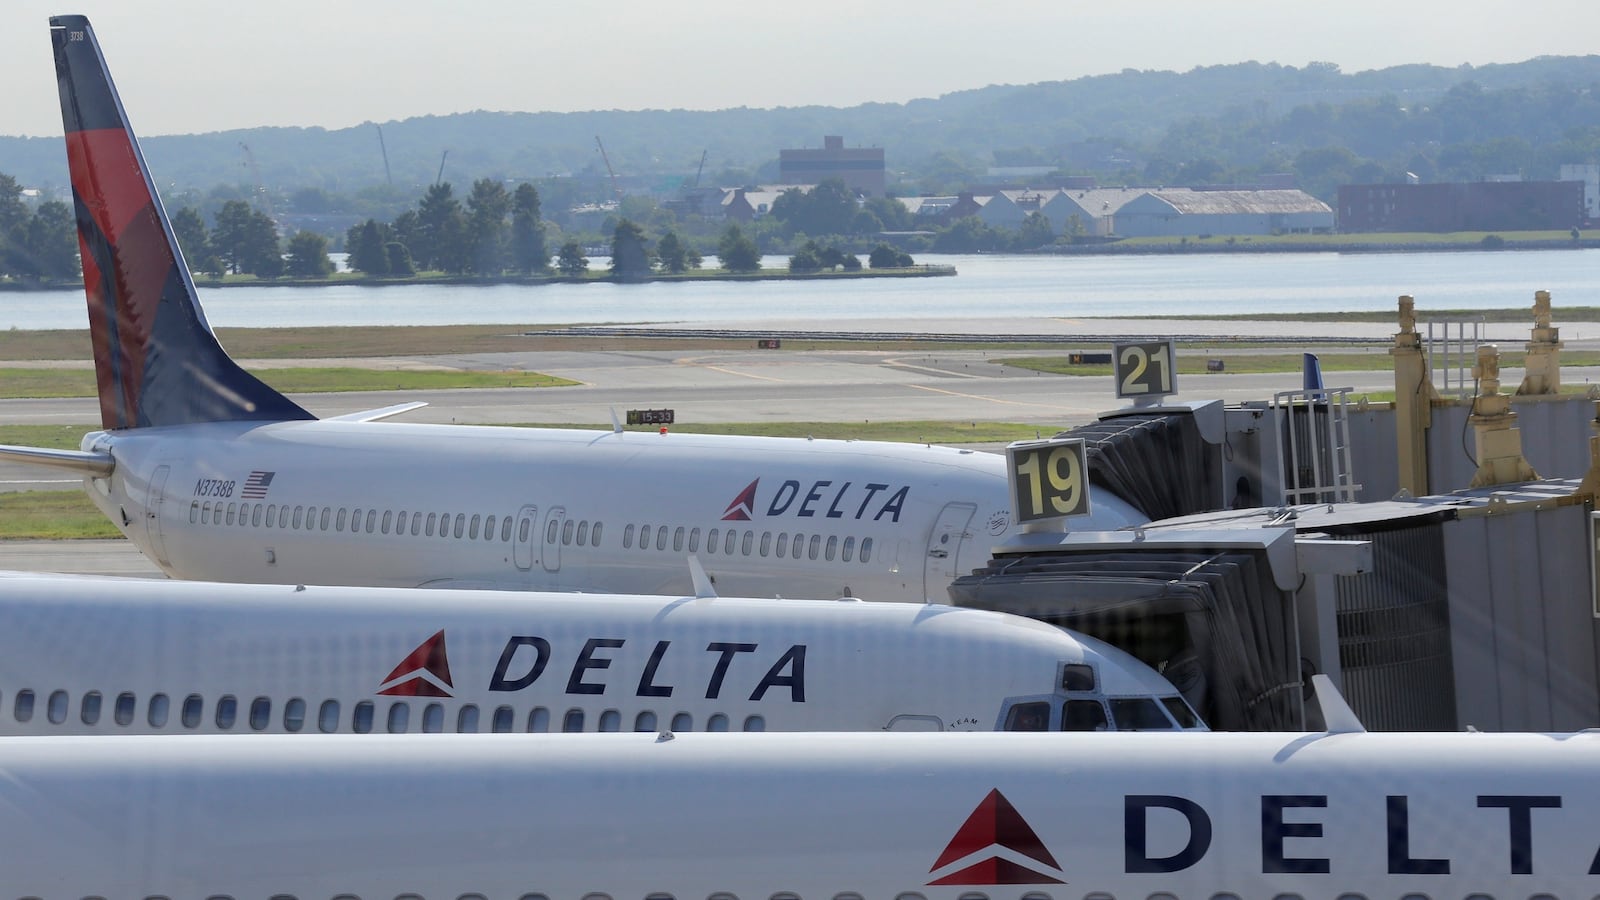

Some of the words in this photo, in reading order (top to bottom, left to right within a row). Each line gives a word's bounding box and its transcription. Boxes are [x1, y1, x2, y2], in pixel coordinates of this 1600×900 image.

[70, 31, 84, 41] 3738
[1119, 345, 1171, 395] 21
[642, 411, 672, 422] 15-33
[194, 478, 236, 498] N3738B
[766, 479, 911, 523] DELTA
[1017, 446, 1082, 515] 19
[488, 635, 807, 703] DELTA
[1124, 795, 1600, 875] DELT
